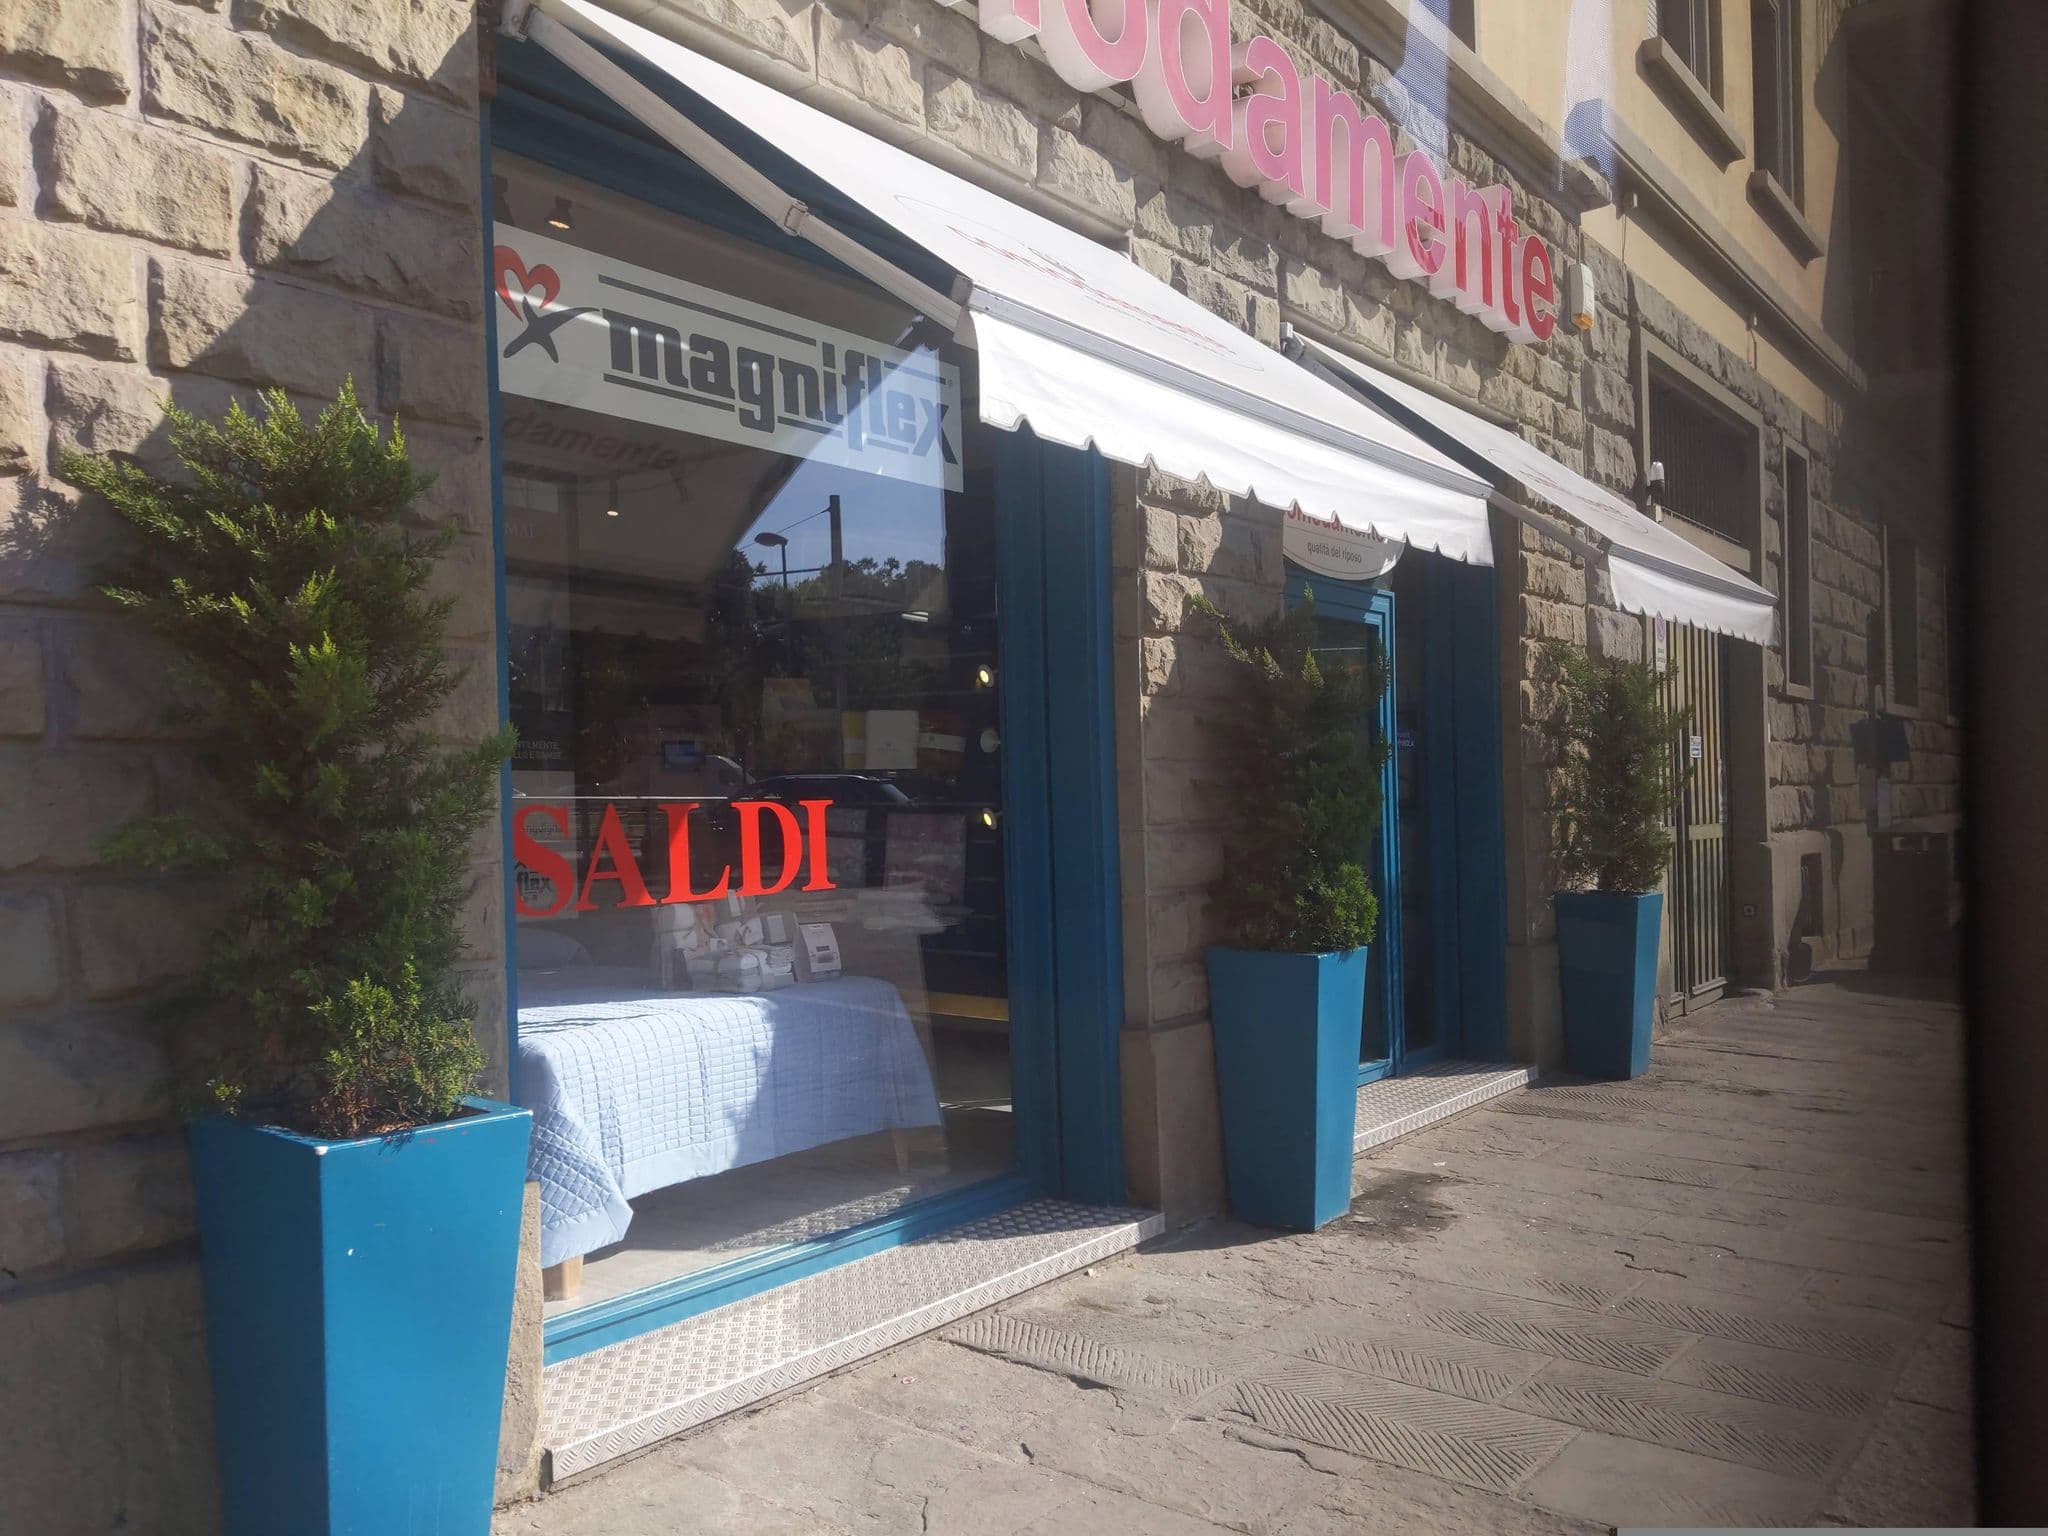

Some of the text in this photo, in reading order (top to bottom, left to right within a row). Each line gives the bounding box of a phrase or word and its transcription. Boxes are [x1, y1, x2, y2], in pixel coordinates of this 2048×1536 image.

[602, 308, 959, 465] magniflex
[1330, 546, 1341, 560] del
[1342, 549, 1362, 564] riposo
[514, 800, 836, 917] SALDI
